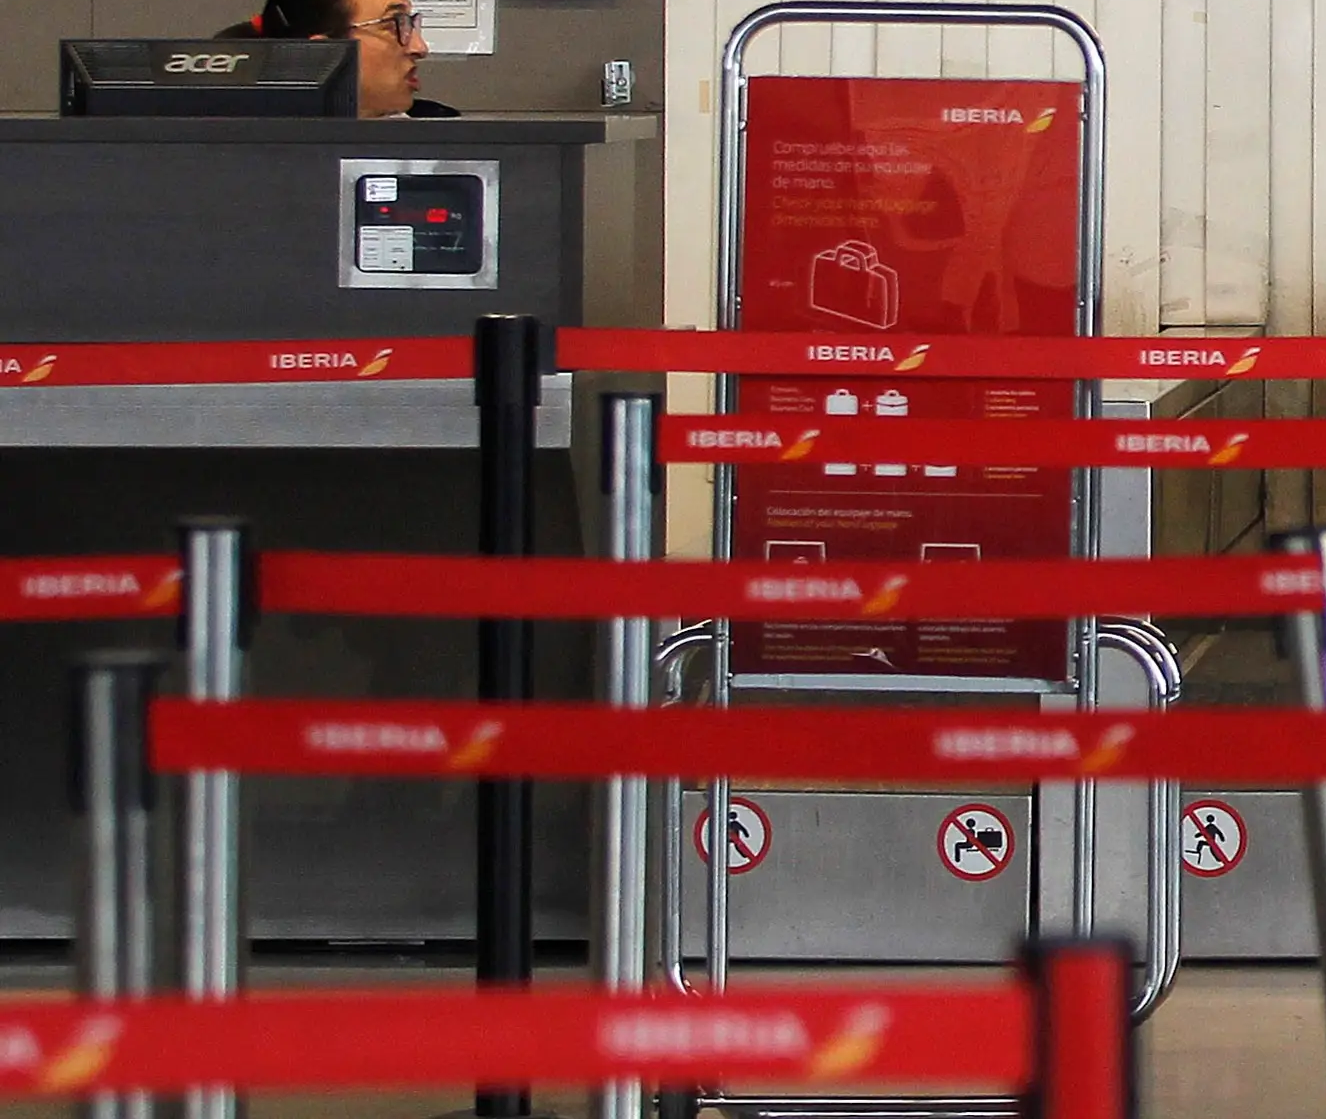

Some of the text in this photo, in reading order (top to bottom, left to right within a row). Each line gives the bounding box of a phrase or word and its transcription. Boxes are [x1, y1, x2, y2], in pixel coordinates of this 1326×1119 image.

[164, 52, 249, 74] acer
[940, 107, 1024, 125] IBERIA
[270, 352, 358, 370] IBERIA
[808, 344, 895, 362] IBERIA
[1138, 349, 1226, 367] IBERIA
[686, 430, 783, 449] IBERIA
[1116, 434, 1211, 453] IBERIA
[22, 572, 140, 597] IBERIA
[745, 578, 862, 601] IBERIA
[305, 723, 448, 752] IBERIA
[932, 728, 1080, 760] IBERIA
[597, 1009, 810, 1059] IBERIA
